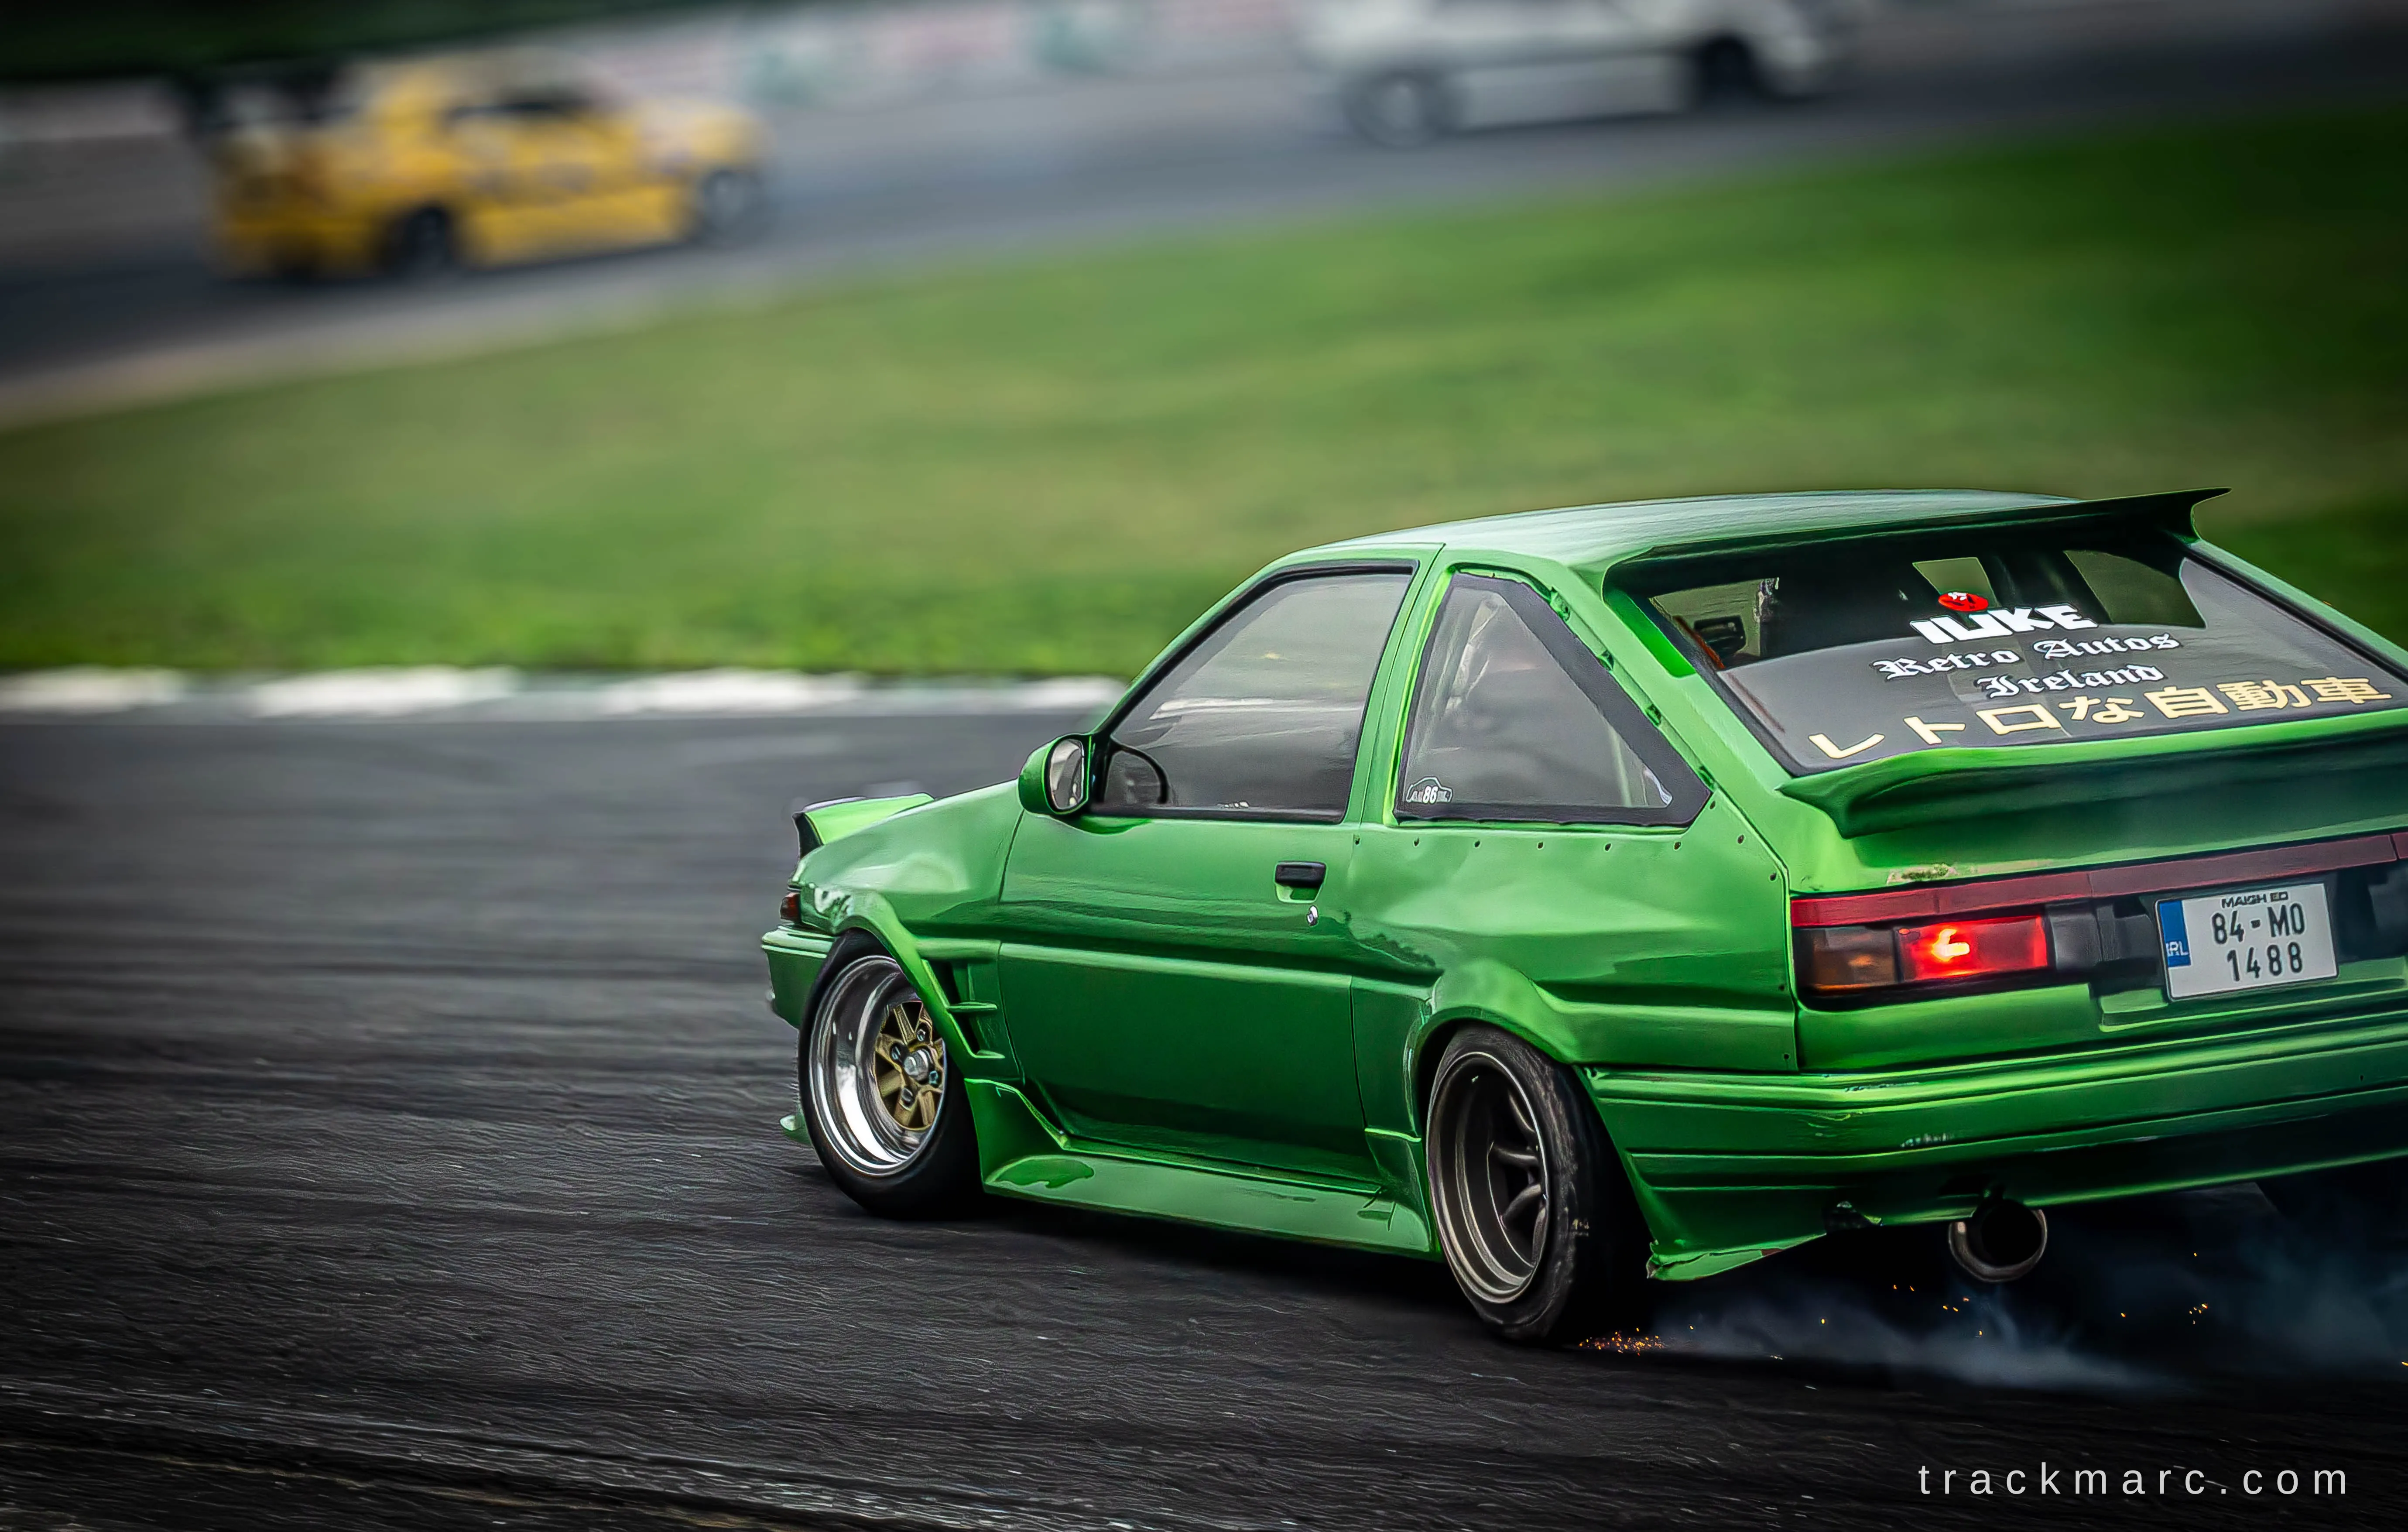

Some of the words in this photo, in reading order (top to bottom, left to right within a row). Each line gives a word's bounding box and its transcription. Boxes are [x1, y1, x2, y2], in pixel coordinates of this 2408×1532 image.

[1873, 650, 2021, 681] Retro
[2032, 632, 2181, 660] Autos
[1976, 663, 2165, 698] Ireland
[1807, 676, 2394, 760] レトロな自動車
[2165, 940, 2189, 957] IRL
[2226, 941, 2303, 982] 1488
